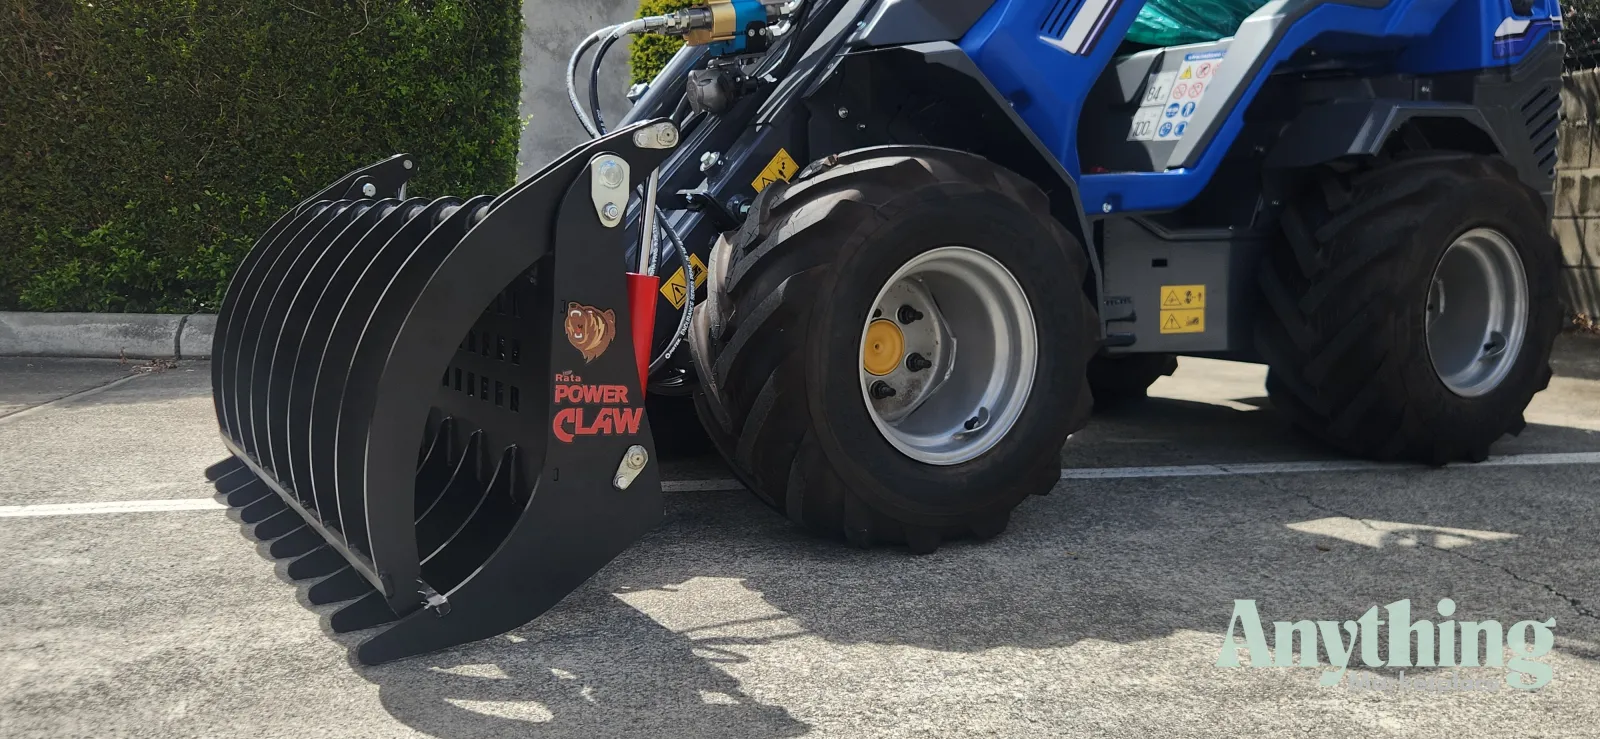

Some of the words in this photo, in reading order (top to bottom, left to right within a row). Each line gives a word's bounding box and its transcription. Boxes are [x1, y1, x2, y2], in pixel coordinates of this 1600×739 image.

[555, 373, 582, 382] Rata
[554, 384, 629, 403] POWER
[552, 407, 644, 443] CLAW
